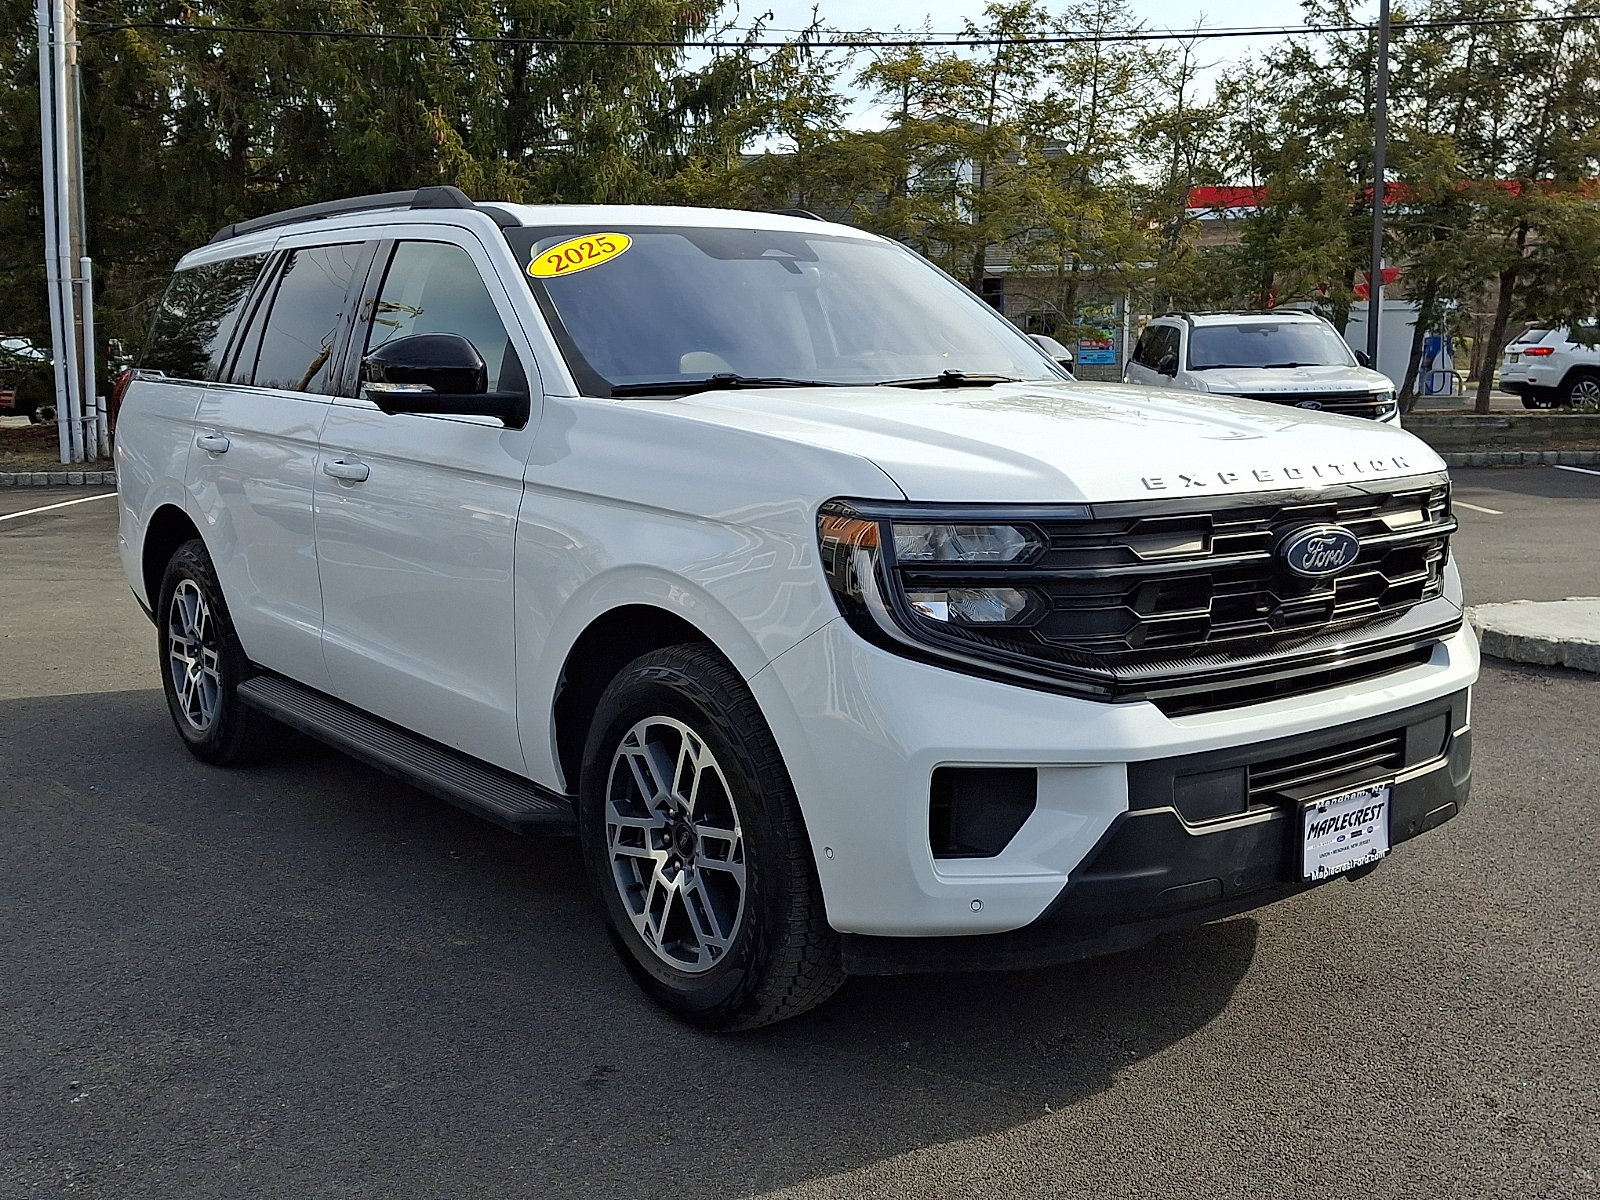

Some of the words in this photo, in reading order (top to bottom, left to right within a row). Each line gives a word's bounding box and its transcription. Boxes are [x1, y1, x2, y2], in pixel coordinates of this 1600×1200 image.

[547, 236, 616, 272] 2025
[1141, 456, 1411, 490] EXPEDITION
[1301, 535, 1347, 570] Ford
[1306, 802, 1385, 841] MAPLECREST
[1311, 851, 1386, 881] MaplecrestFord.com
